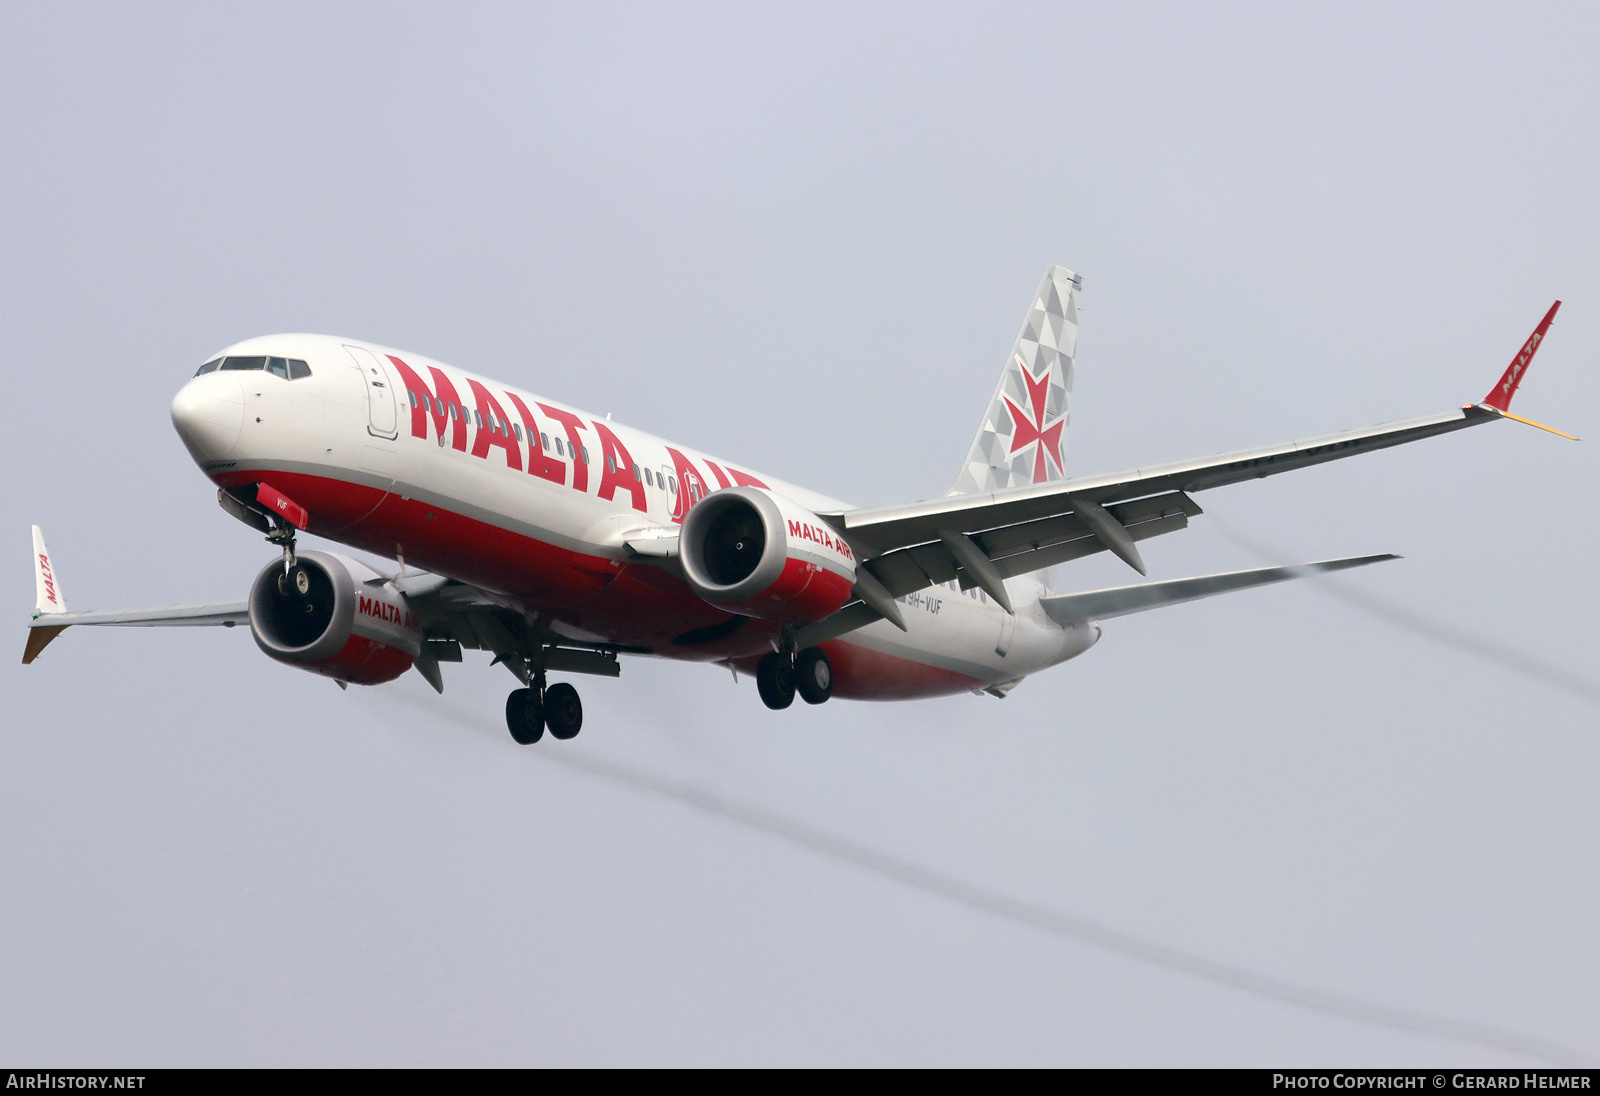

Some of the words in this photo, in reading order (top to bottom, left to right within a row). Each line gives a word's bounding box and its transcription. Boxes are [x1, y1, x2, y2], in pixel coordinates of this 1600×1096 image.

[1503, 332, 1542, 395] MALTA
[386, 354, 648, 513] MALTA
[277, 497, 288, 510] VUF
[788, 519, 834, 549] MALTA
[835, 536, 853, 561] AIR
[38, 553, 57, 605] MALTA
[359, 595, 402, 626] MALTA
[907, 591, 943, 615] 9H-VUF
